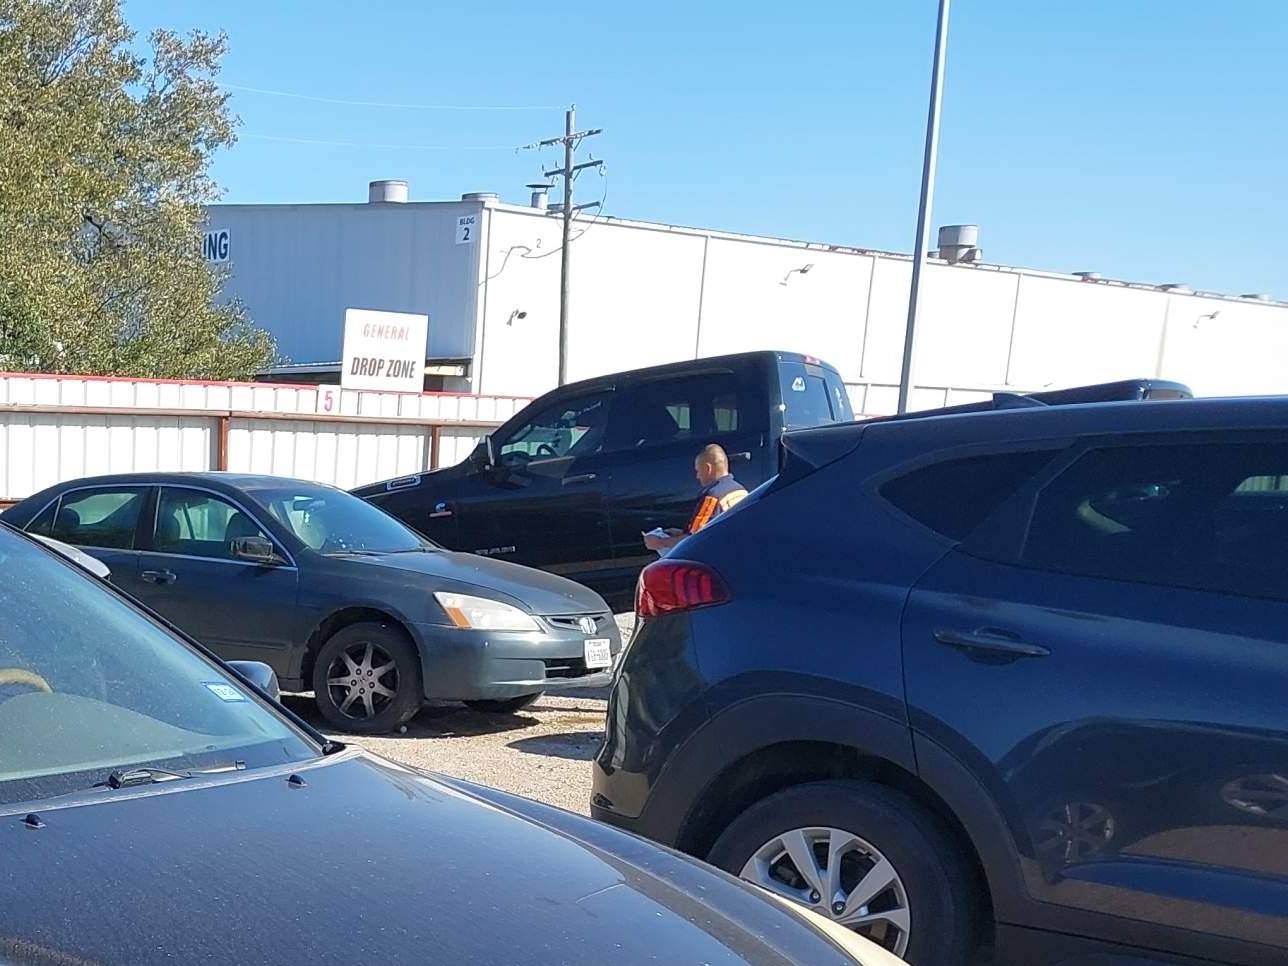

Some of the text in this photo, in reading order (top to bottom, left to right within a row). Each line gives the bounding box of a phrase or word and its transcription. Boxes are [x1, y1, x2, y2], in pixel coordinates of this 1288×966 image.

[459, 216, 475, 226] BLDG
[463, 227, 470, 240] 2
[363, 323, 410, 341] GENERAL
[350, 357, 416, 379] DROP ZONE
[324, 391, 333, 411] 5
